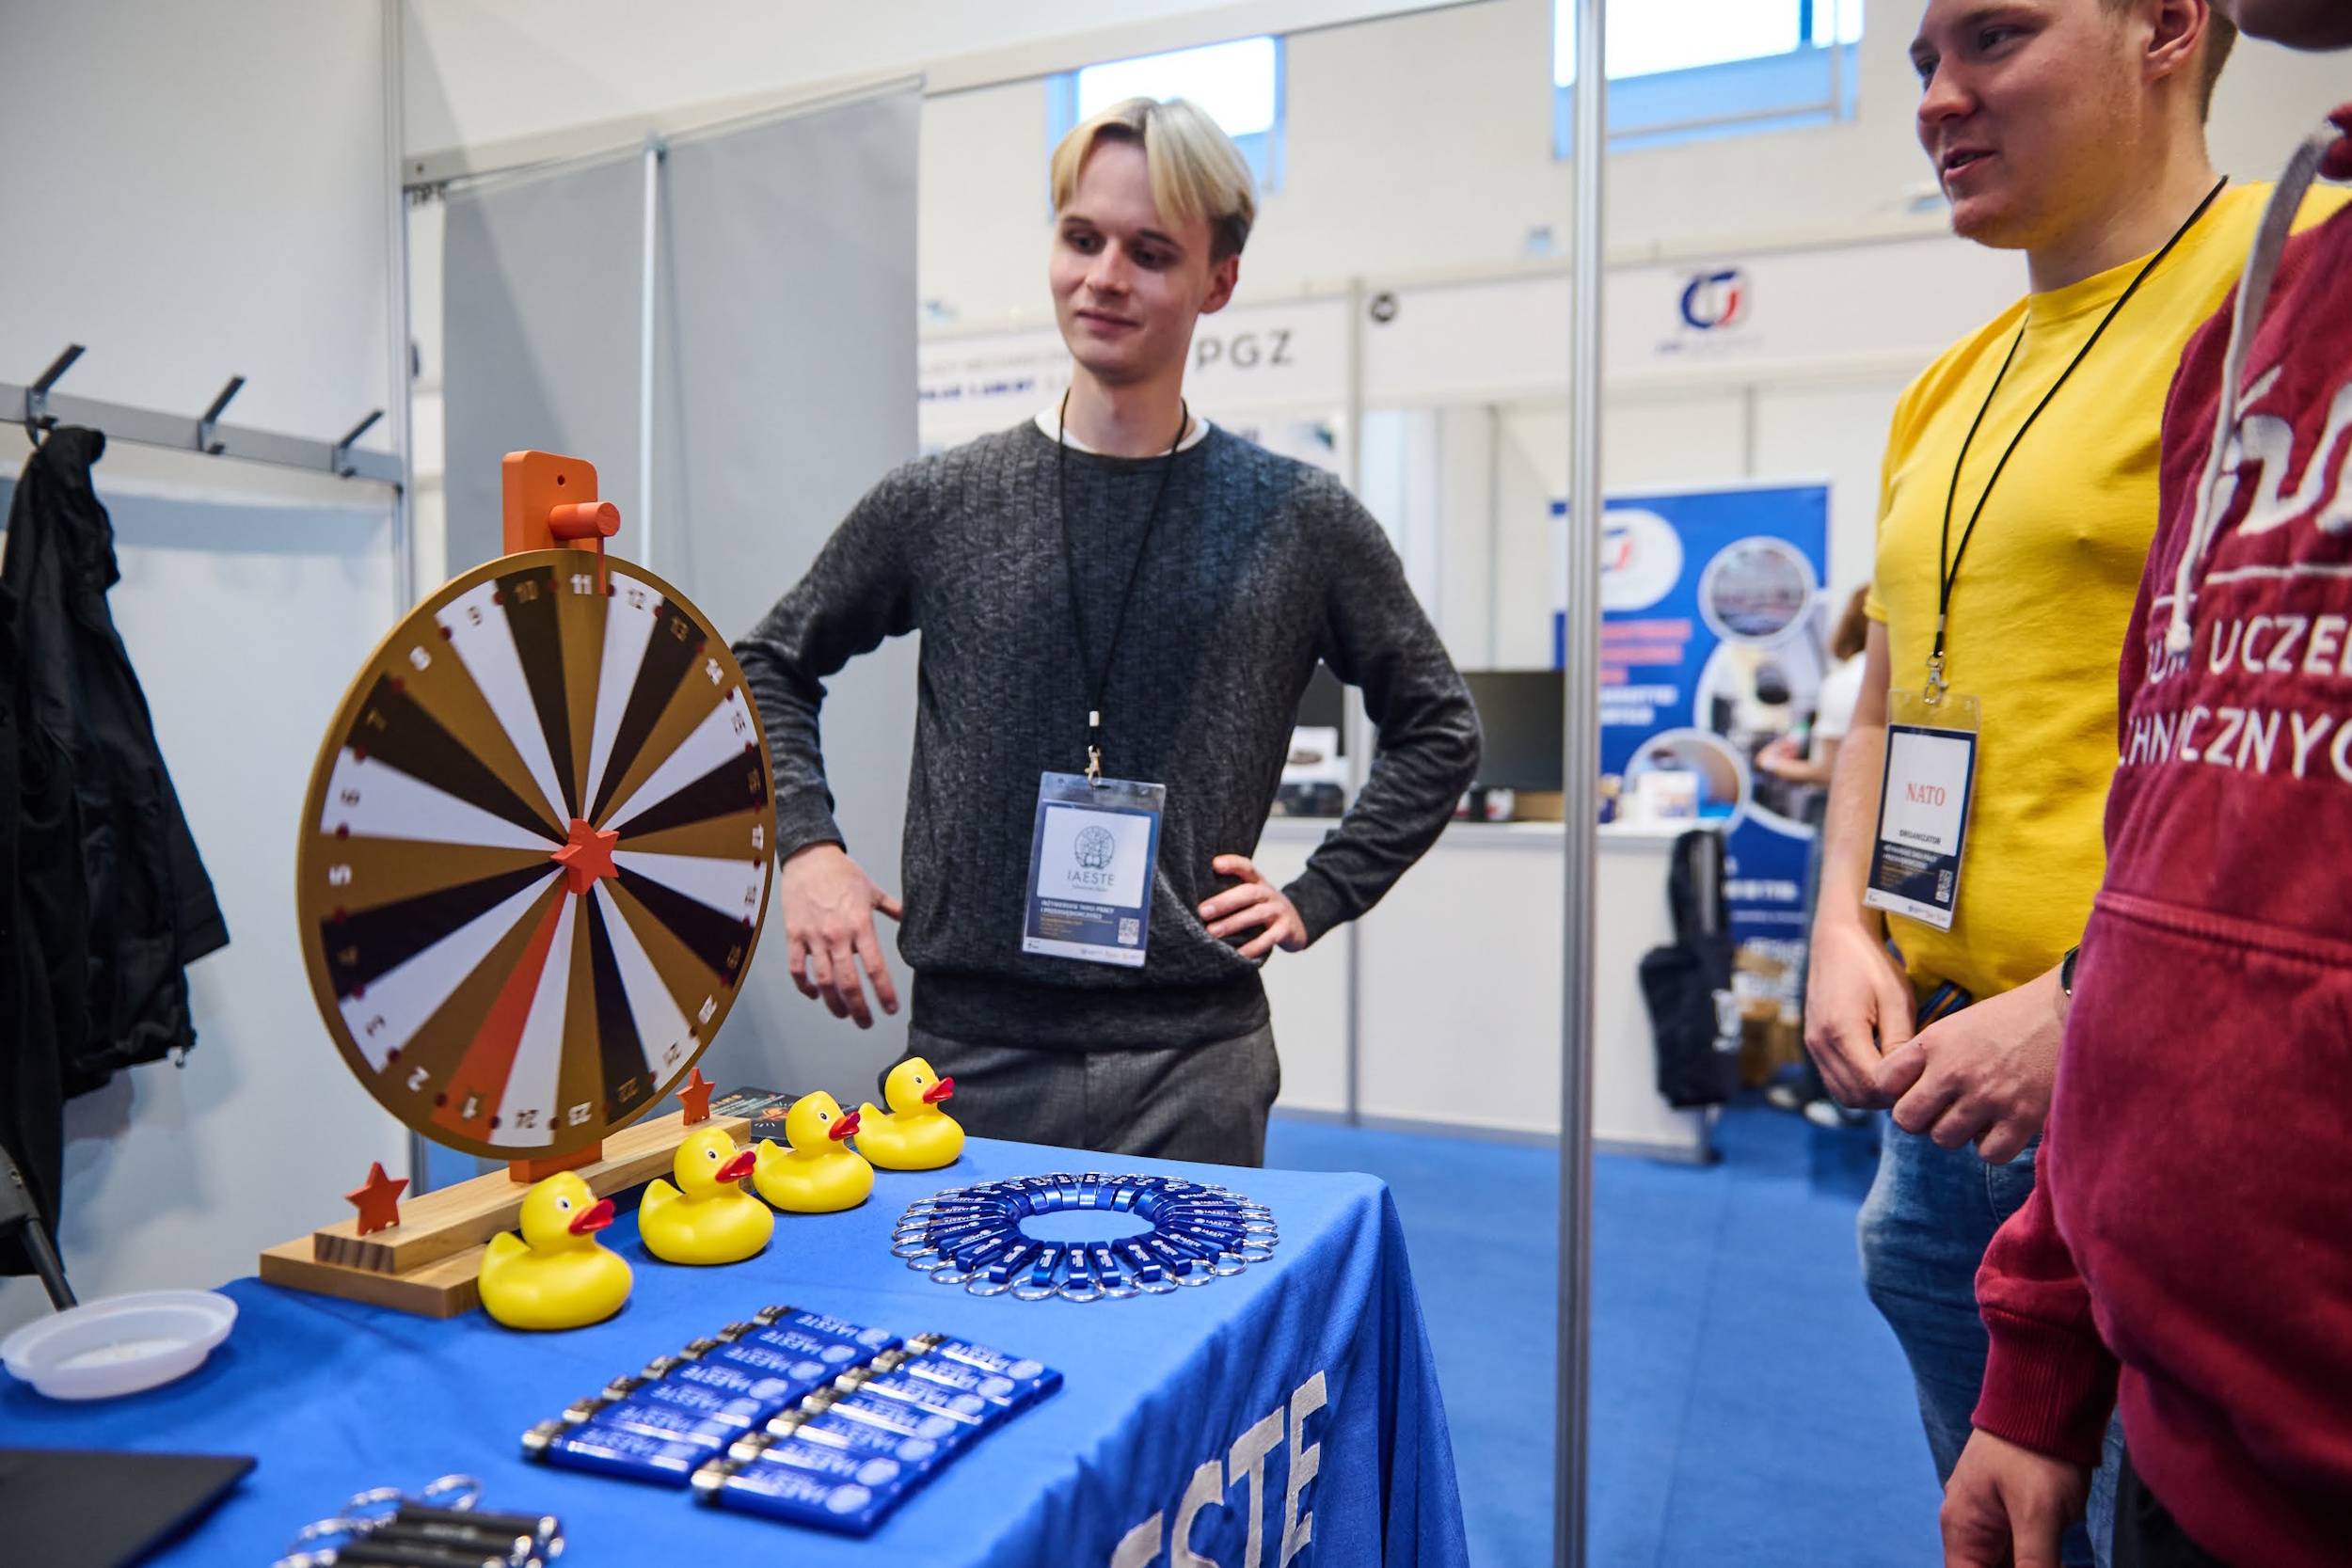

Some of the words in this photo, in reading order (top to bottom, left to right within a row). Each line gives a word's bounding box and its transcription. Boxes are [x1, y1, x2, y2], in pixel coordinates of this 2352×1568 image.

[1195, 330, 1295, 371] PGZ
[570, 574, 594, 595] 11
[627, 587, 646, 610] 12
[670, 615, 690, 641] 13
[409, 646, 432, 671] 8
[705, 658, 725, 686] 14
[1906, 782, 1947, 807] NATO
[1899, 830, 1942, 846] ORGANIZATOR
[328, 864, 351, 886] 5
[1067, 869, 1116, 886] IAESTE
[406, 1066, 430, 1091] 2
[462, 1097, 479, 1119] 1
